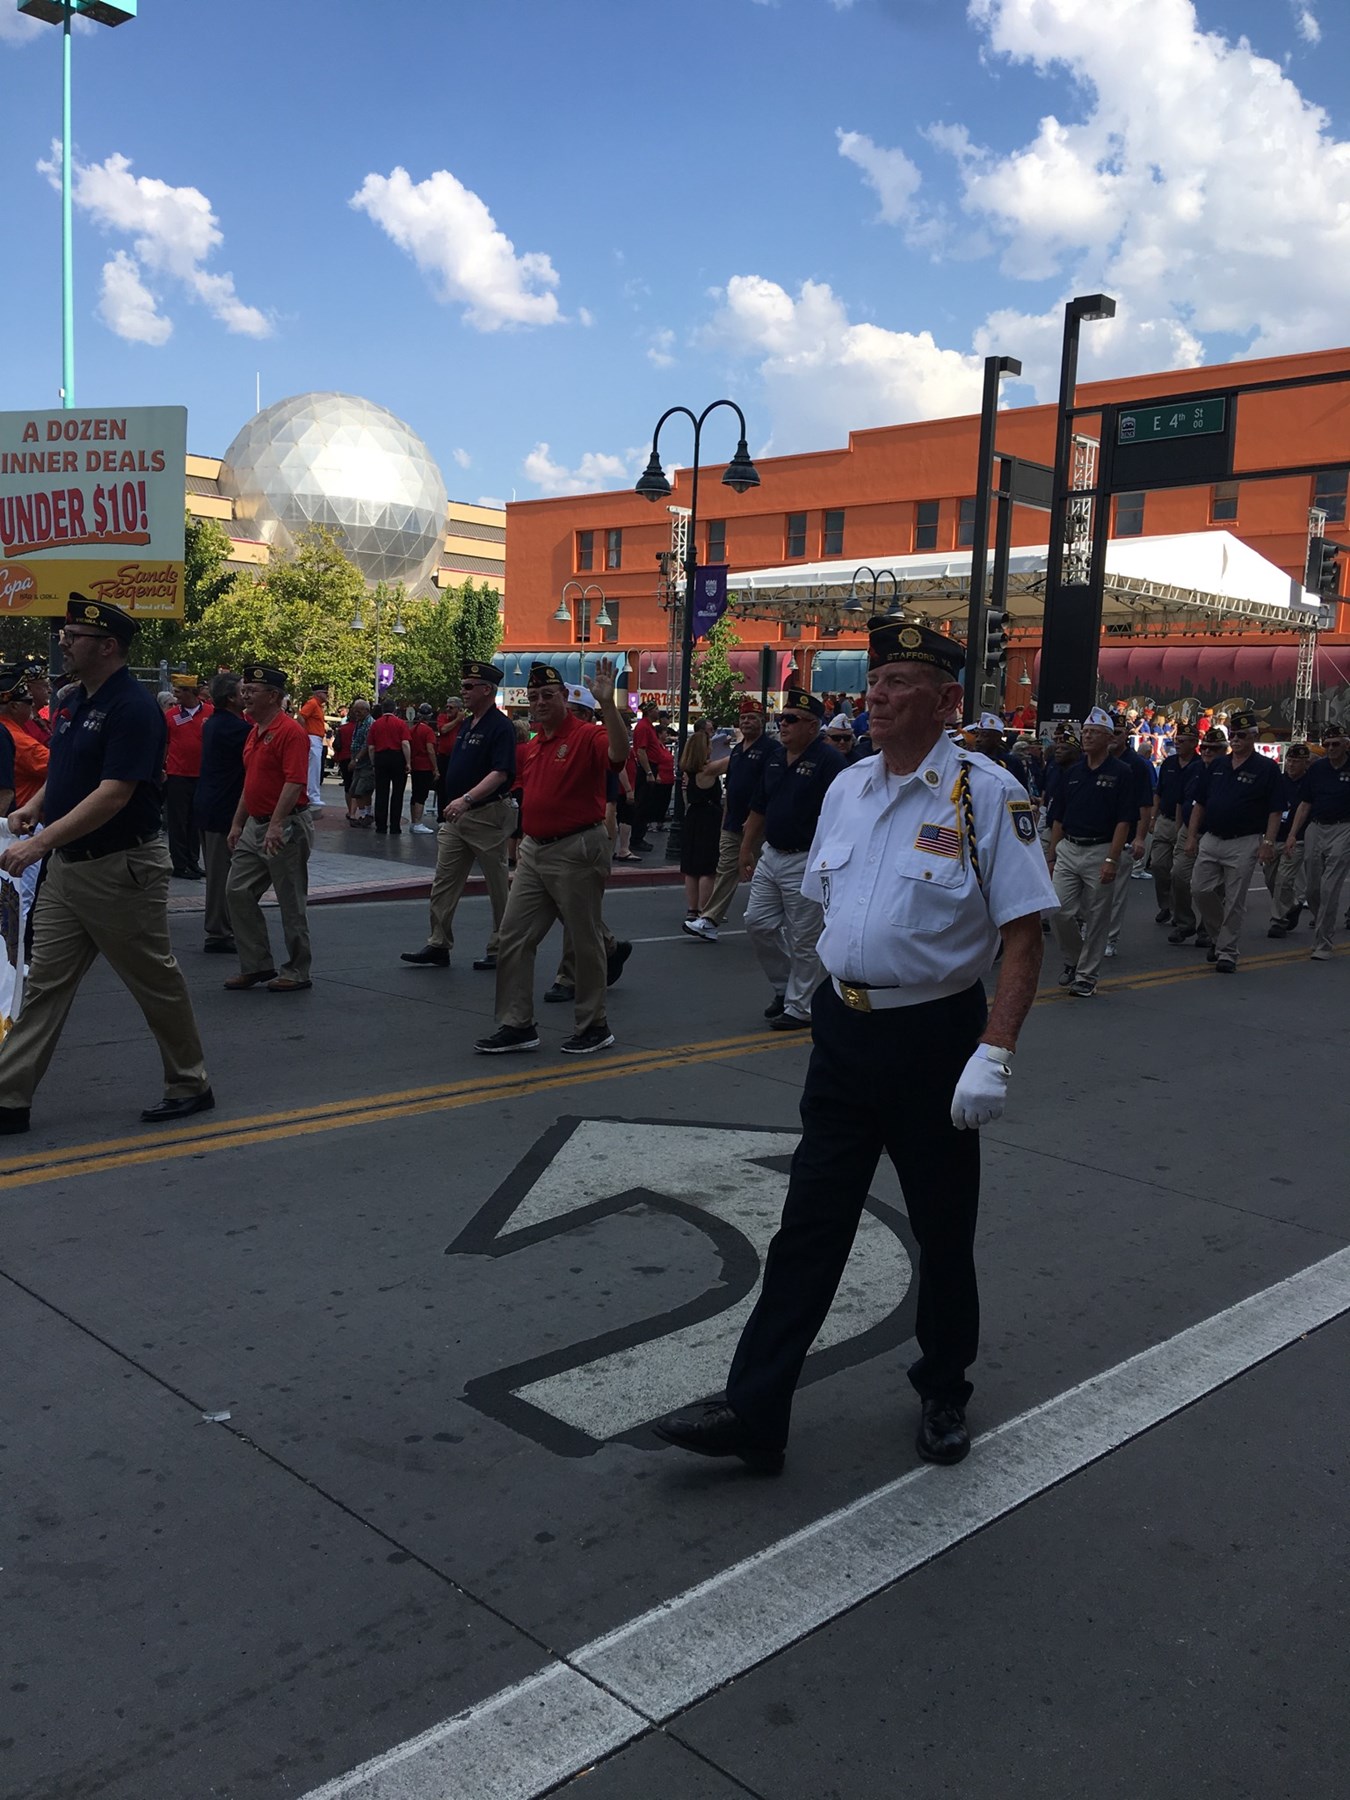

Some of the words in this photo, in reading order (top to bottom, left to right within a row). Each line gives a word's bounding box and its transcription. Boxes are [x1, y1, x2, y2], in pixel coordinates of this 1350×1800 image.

[22, 421, 39, 443] A
[47, 418, 127, 442] DOZEN
[1153, 416, 1161, 431] E
[1169, 413, 1186, 428] 4th
[1194, 407, 1204, 418] St
[1, 451, 78, 474] INNER
[86, 449, 166, 473] DEALS
[0, 487, 88, 546] UNDER
[93, 480, 148, 537] $10!
[117, 563, 179, 586] Sands
[88, 578, 178, 611] Regency
